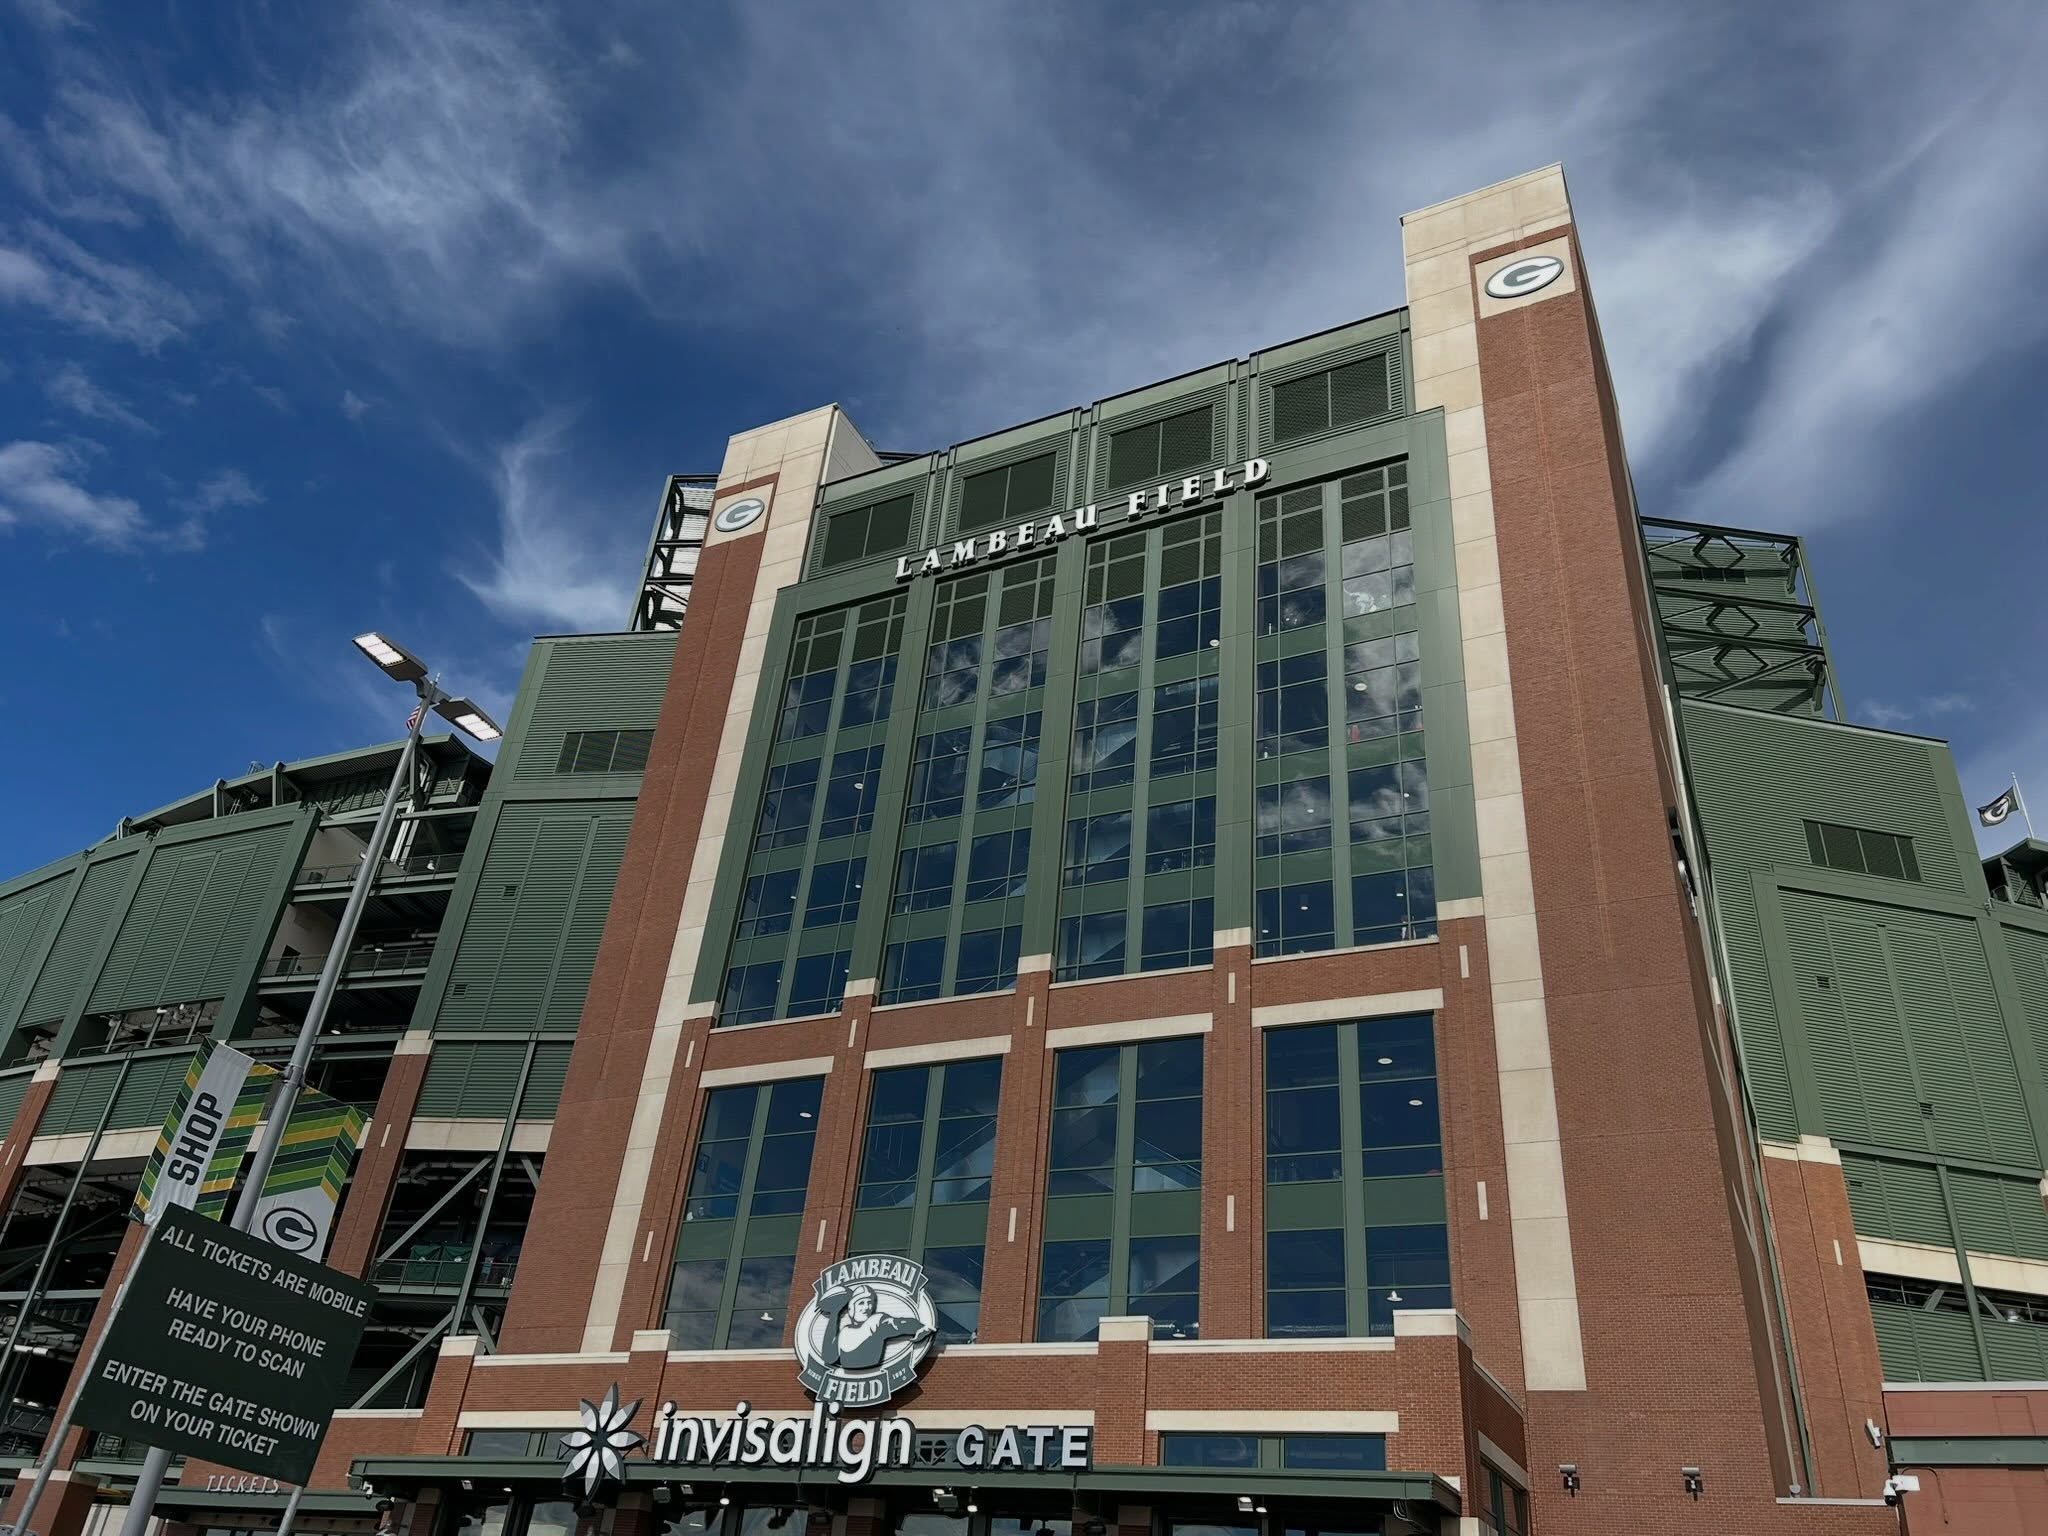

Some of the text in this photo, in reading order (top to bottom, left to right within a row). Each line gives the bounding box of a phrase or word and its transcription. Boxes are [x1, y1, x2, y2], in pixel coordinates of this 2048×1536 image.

[896, 458, 1272, 581] LAMBEAU FIELD
[168, 1092, 223, 1186] SHOP
[160, 1225, 367, 1318] ALL TICKETS ARE MOBILE
[825, 1259, 917, 1288] LAMBEAU
[166, 1287, 326, 1357] HAVE YOUR PHONE
[168, 1318, 306, 1379] READY TO SCAN
[102, 1359, 320, 1440] ENTER THE GATE SHOWN
[823, 1379, 883, 1402] FIELD
[130, 1400, 279, 1457] ON YOUR TICKET
[653, 1400, 1090, 1484] invisalign GATE
[206, 1475, 279, 1494] TICKETS
